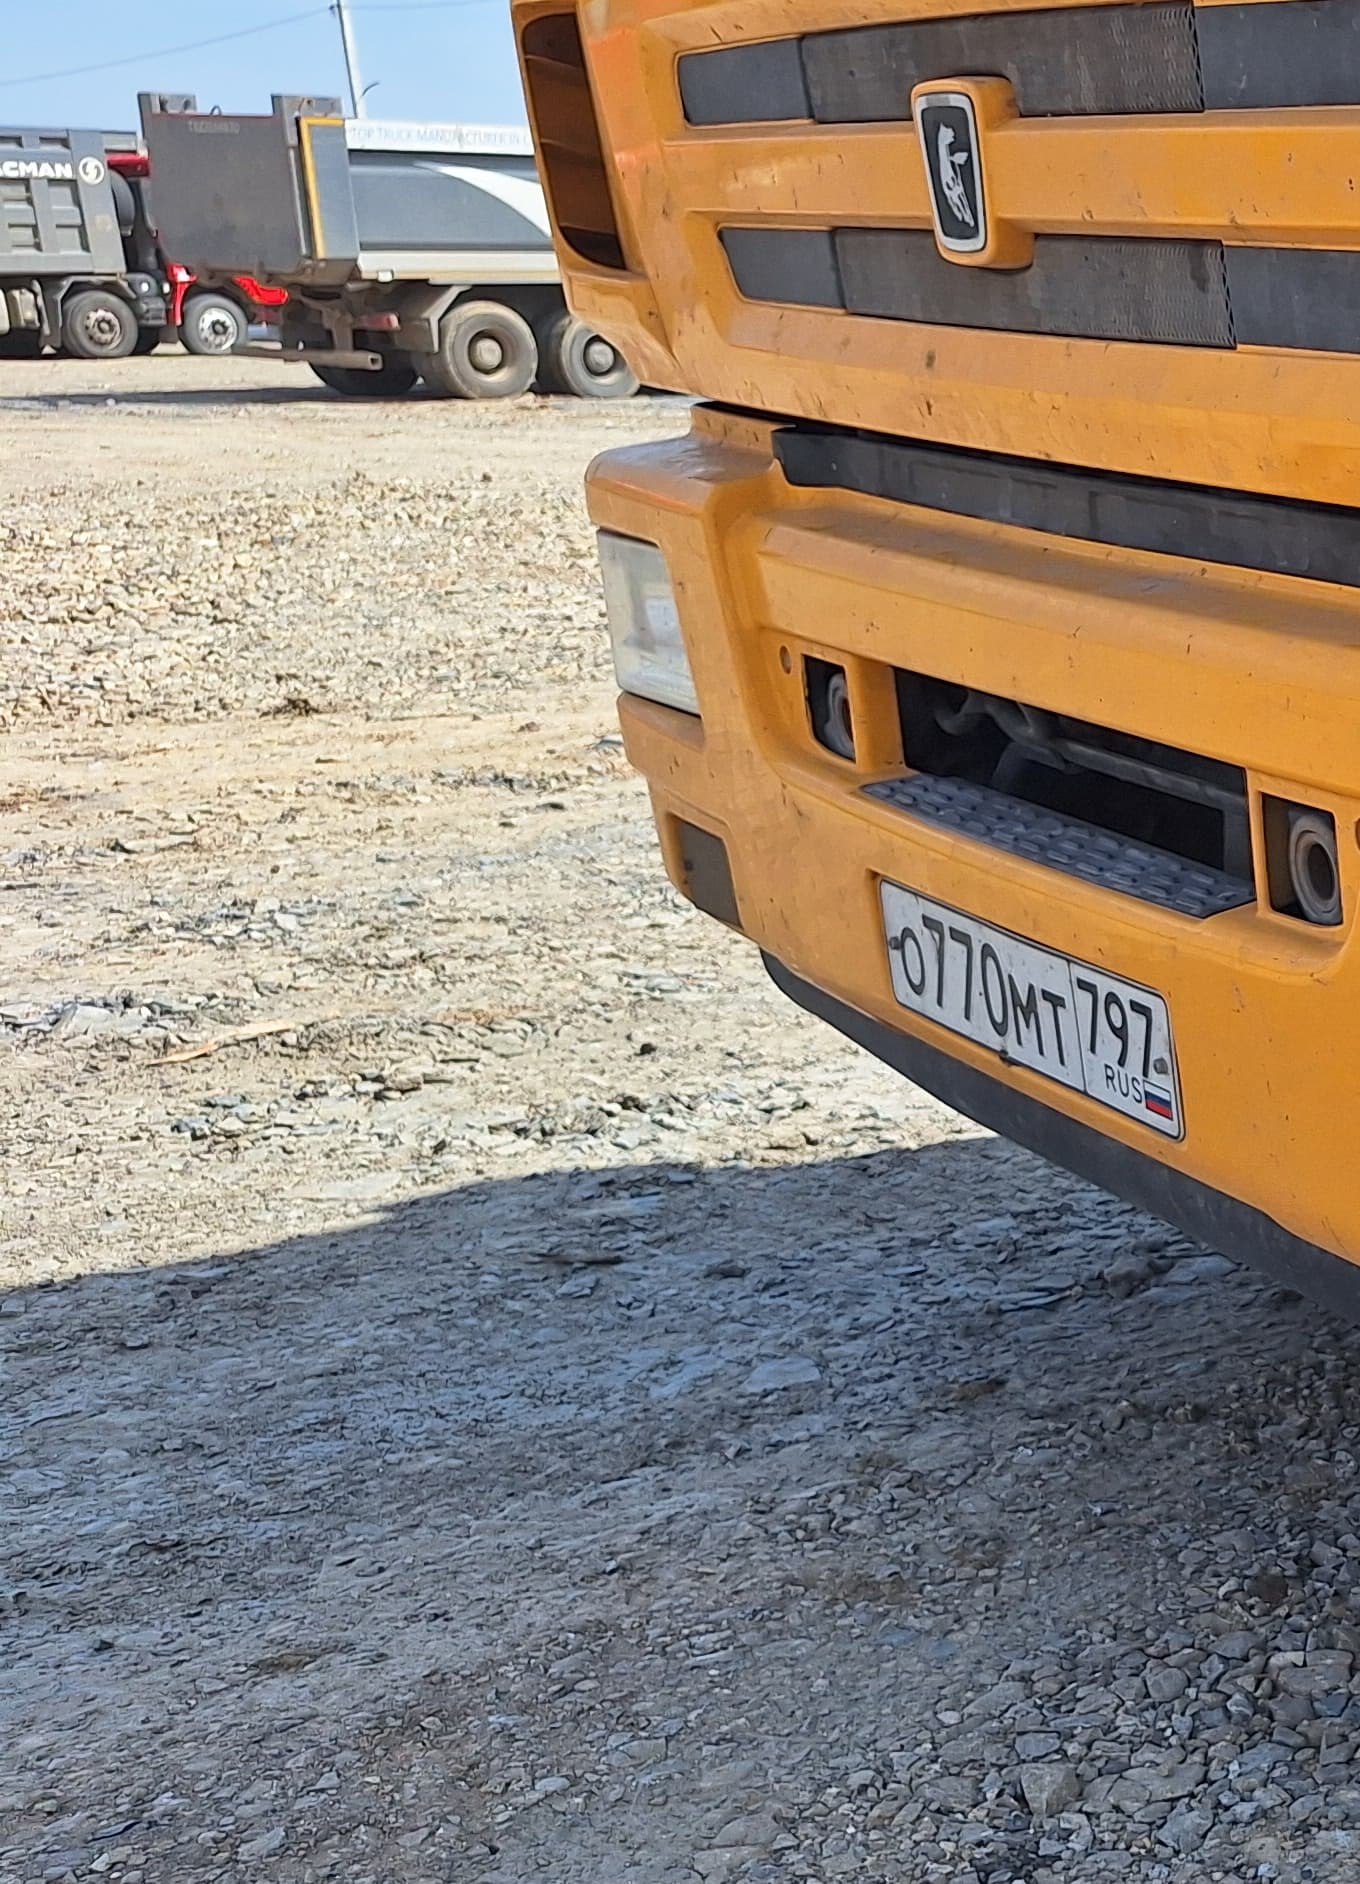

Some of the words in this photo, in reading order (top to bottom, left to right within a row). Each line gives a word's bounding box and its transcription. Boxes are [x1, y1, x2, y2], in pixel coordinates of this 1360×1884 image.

[377, 127, 411, 142] TRUCK
[0, 161, 73, 179] CMAN
[1077, 977, 1152, 1078] 797
[1104, 1064, 1143, 1104] RUS
